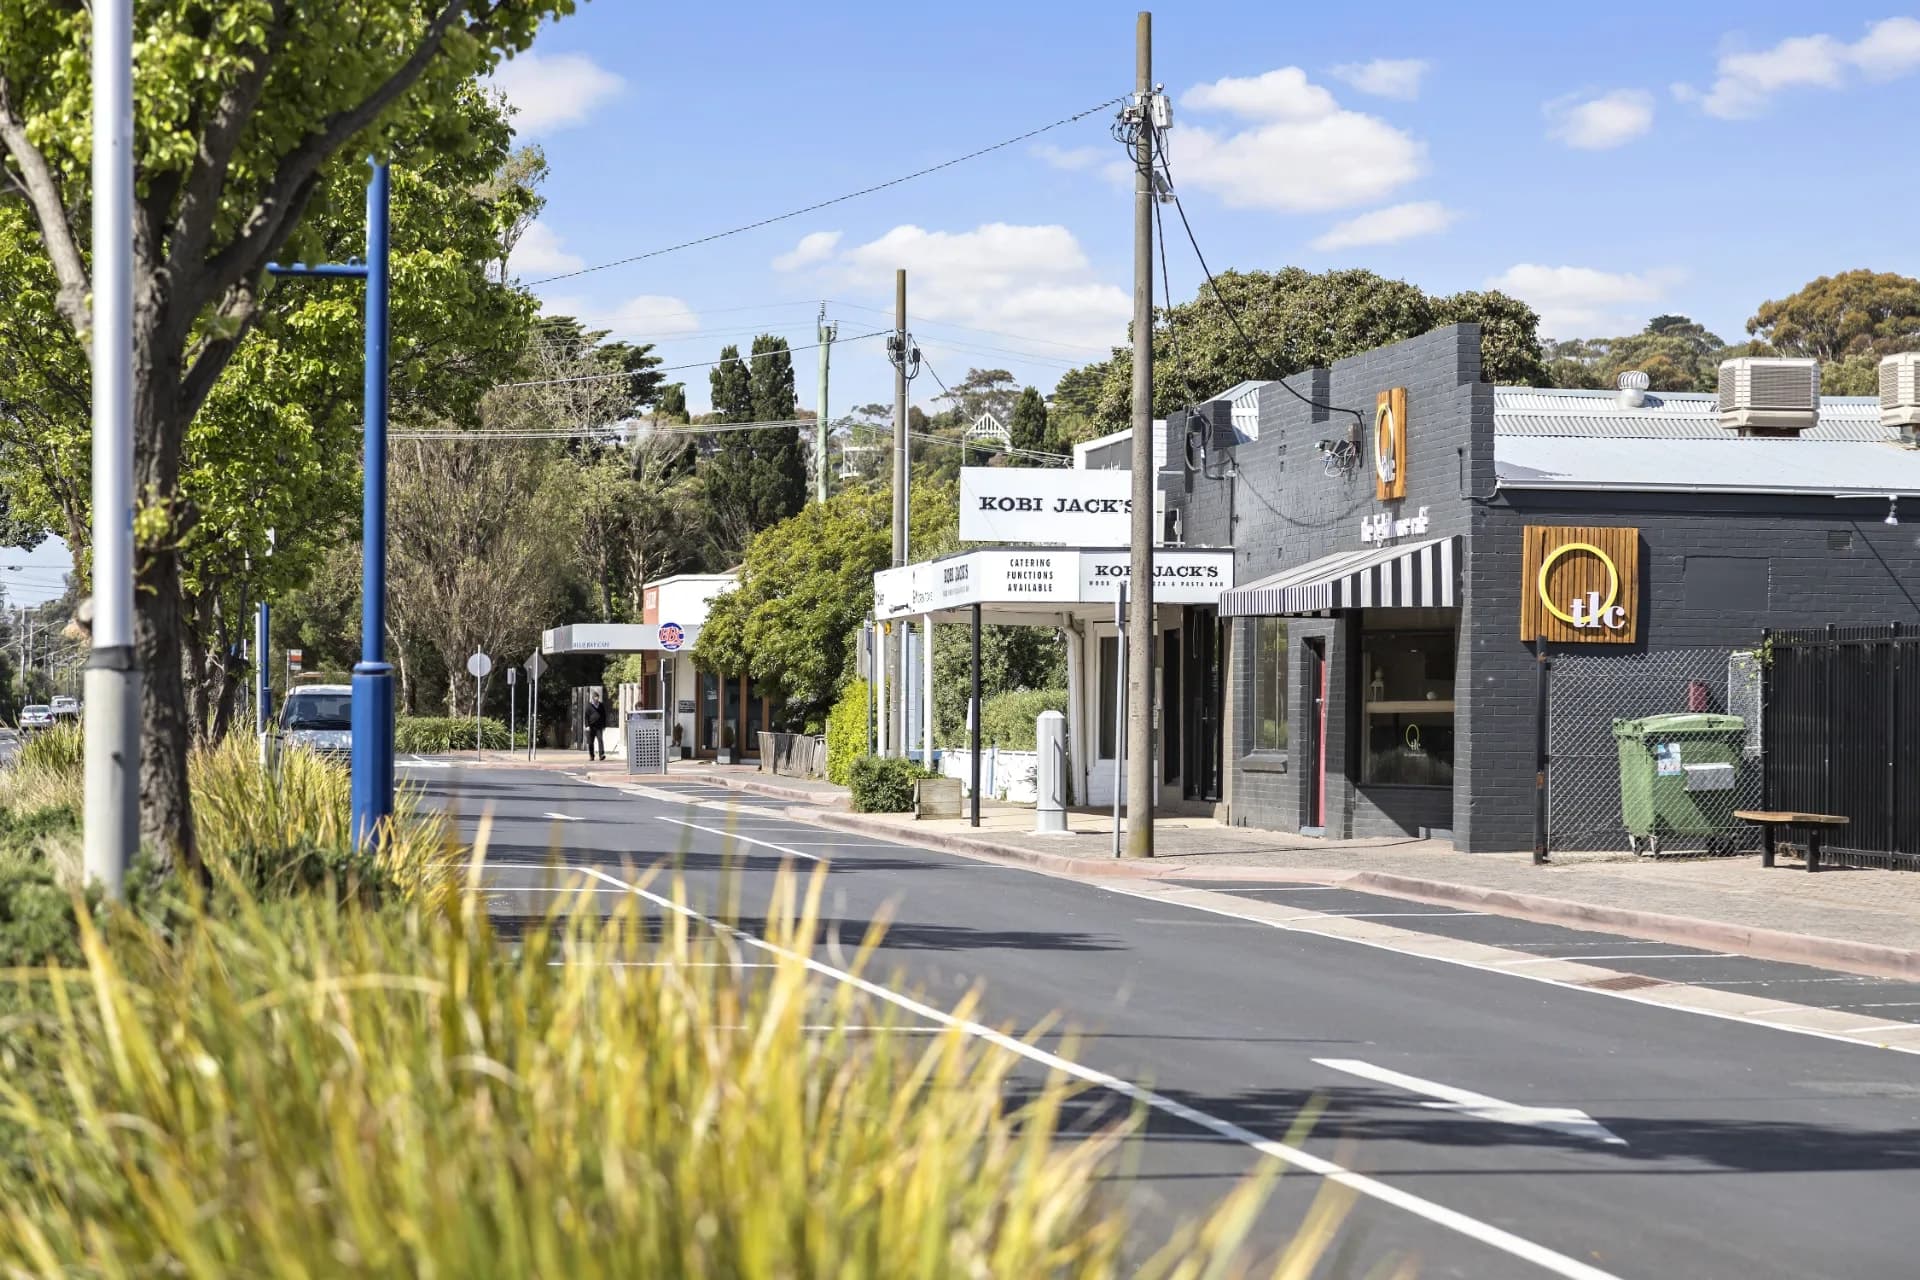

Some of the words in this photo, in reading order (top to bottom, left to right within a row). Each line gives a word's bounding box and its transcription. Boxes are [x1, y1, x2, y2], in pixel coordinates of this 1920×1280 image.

[979, 496, 1043, 512] KOBI
[1009, 558, 1051, 568] CATERING
[1007, 570, 1054, 580] FUNCTIONS
[1153, 566, 1219, 578] JACK'S
[1007, 582, 1053, 593] AVAILABLE
[1570, 591, 1626, 630] tlc
